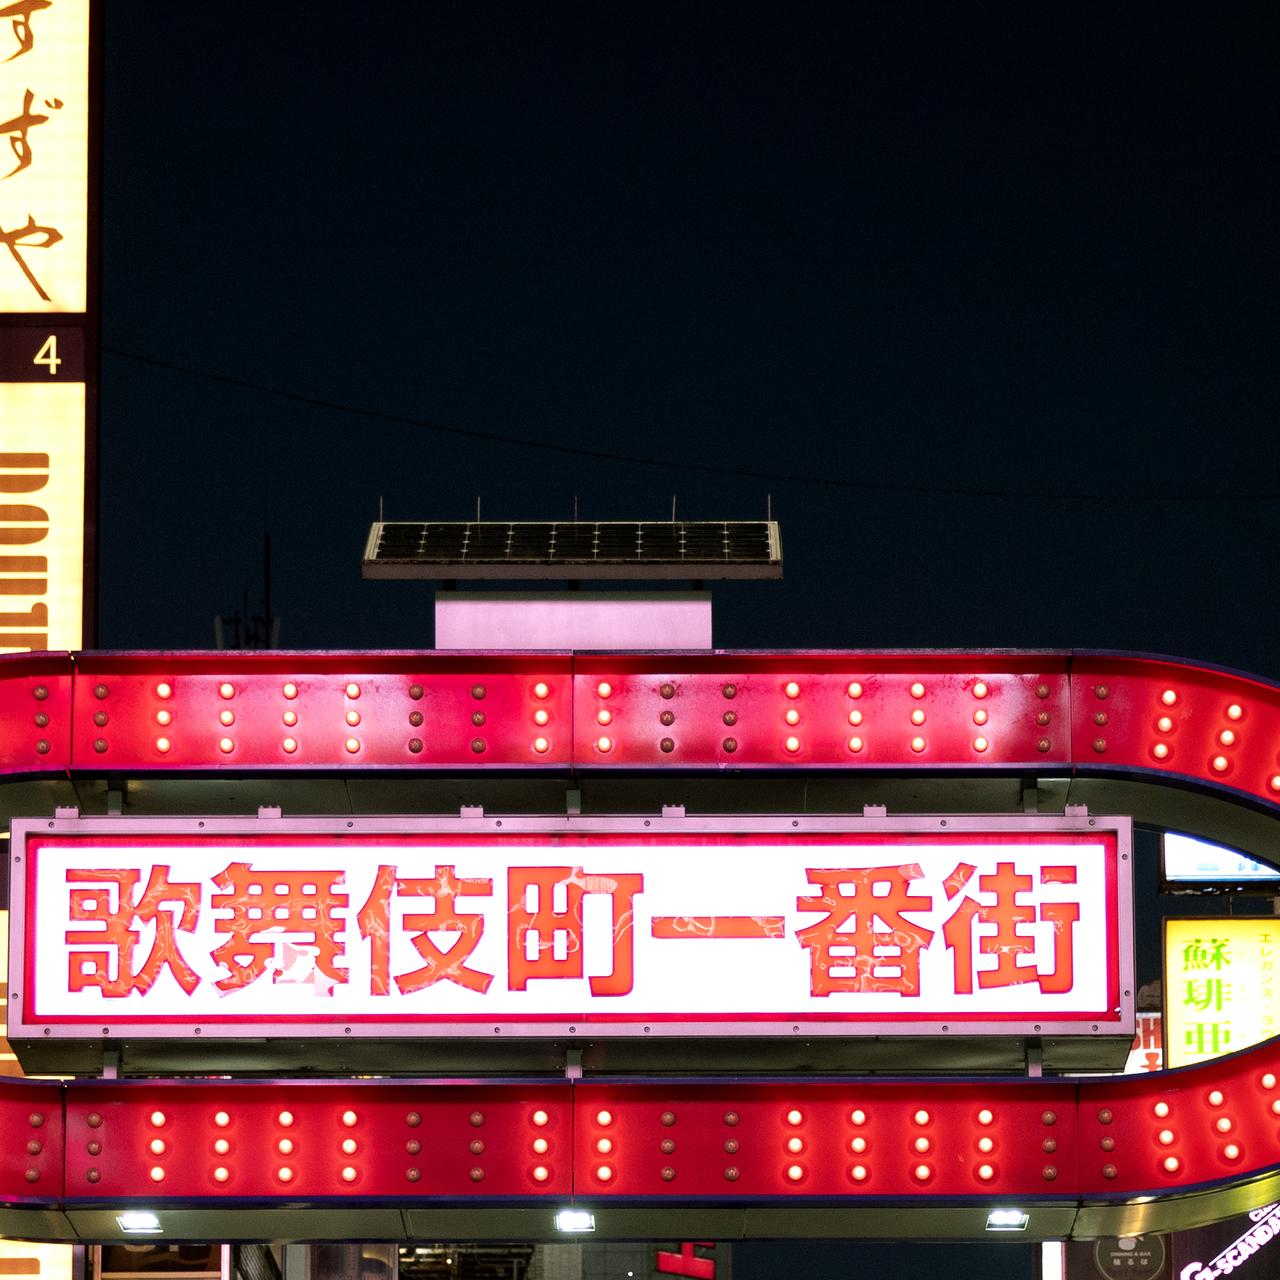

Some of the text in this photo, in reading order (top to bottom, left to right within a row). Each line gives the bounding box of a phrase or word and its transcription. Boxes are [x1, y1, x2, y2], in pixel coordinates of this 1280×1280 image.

[33, 336, 61, 374] 4
[66, 863, 1080, 998] 歌舞伎町一番街
